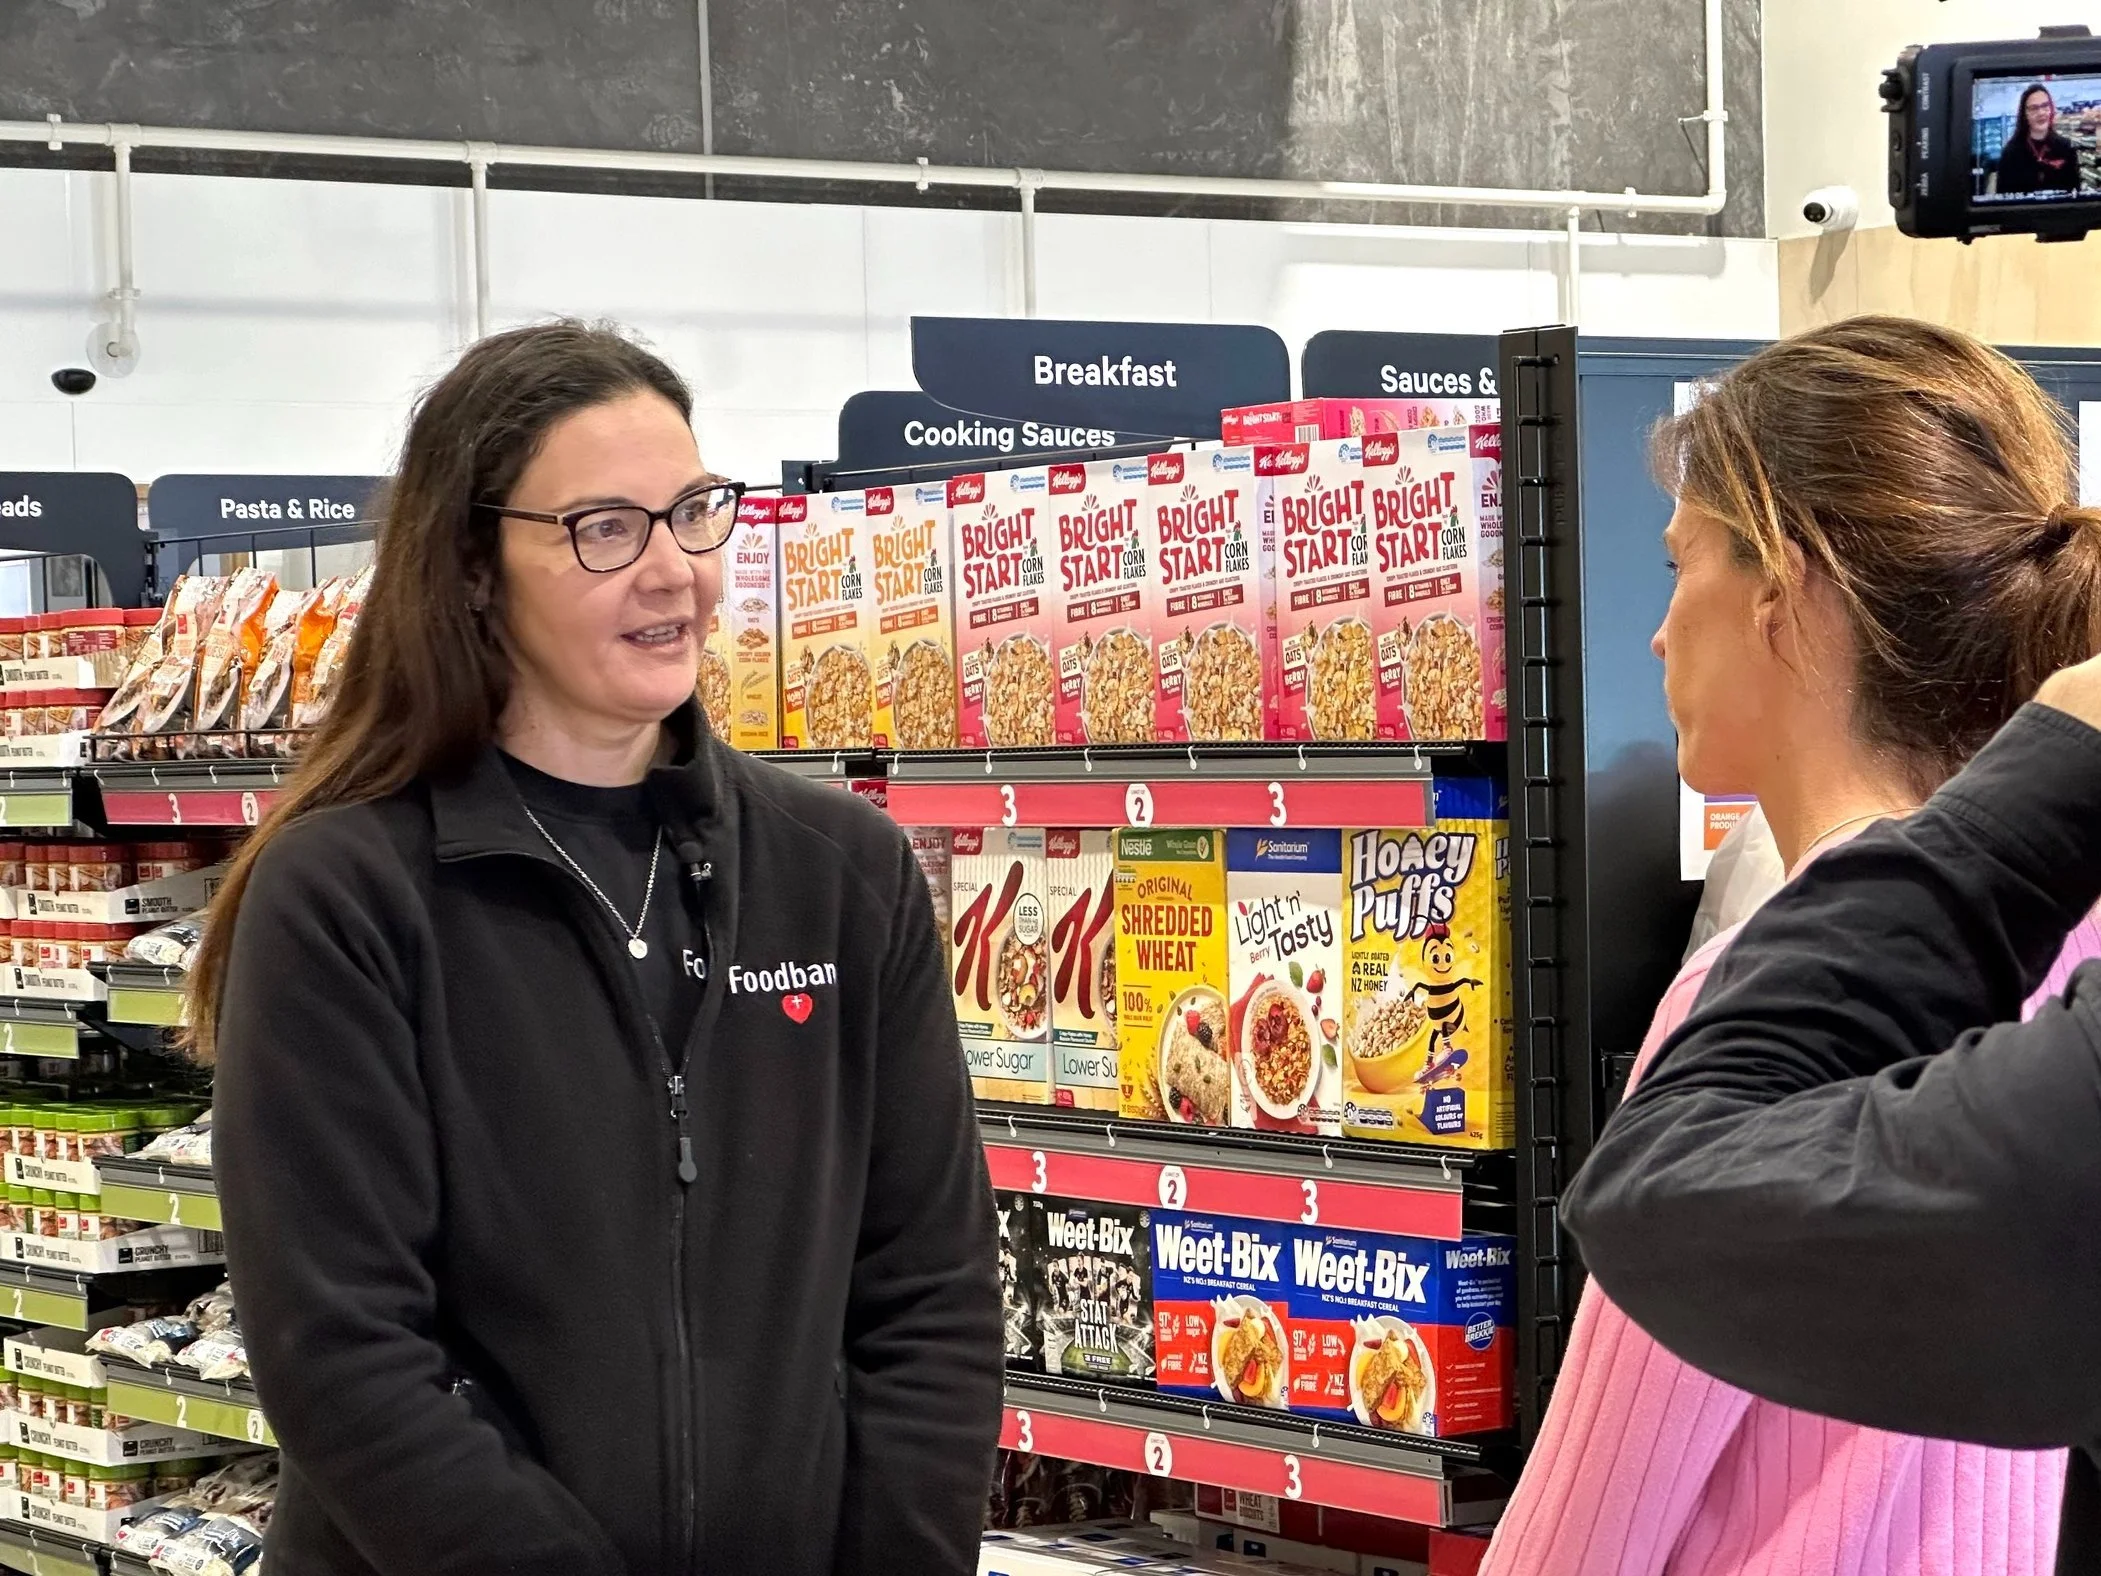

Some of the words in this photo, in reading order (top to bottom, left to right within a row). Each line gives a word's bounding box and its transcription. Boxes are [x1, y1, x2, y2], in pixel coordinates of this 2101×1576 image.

[1033, 355, 1177, 387] Breakfast
[1381, 364, 1473, 395] Sauces
[1478, 366, 1498, 395] &
[905, 421, 1018, 453] Cooking
[1023, 422, 1116, 448] Sauces
[1275, 450, 1305, 470] Kellogg's
[1365, 441, 1396, 461] Kellogg's
[1052, 469, 1083, 489] Kellogg's
[1150, 461, 1180, 480] Kellogg's
[955, 482, 982, 499] Kellogg's
[0, 494, 42, 517] ads
[220, 498, 281, 520] Pasta
[288, 498, 304, 520] &
[309, 498, 355, 520] Rice
[779, 501, 804, 519] Kellogg's
[867, 496, 891, 513] Kellogg's
[1282, 480, 1364, 537] BRIGHT
[1372, 471, 1455, 531] BRIGHT
[1059, 499, 1137, 553] BRIGHT
[1157, 489, 1239, 545] BRIGHT
[962, 507, 1035, 561] BRIGHT
[1441, 527, 1465, 546] CORN
[784, 527, 854, 575] BRIGHT
[872, 520, 936, 570] BRIGHT
[1225, 541, 1248, 559] CORN
[1284, 529, 1352, 579] START
[1375, 521, 1442, 574] START
[1442, 544, 1467, 561] FLAKES
[737, 552, 770, 564] ENJOY
[1022, 556, 1043, 574] CORN
[1123, 549, 1145, 566] CORN
[1159, 536, 1225, 585] START
[1225, 557, 1249, 573] FLAKES
[924, 566, 942, 582] CORN
[963, 552, 1023, 599] START
[1060, 544, 1123, 592] START
[1123, 565, 1146, 579] FLAKES
[841, 573, 862, 589] CORN
[875, 562, 925, 606] START
[924, 581, 943, 595] FLAKES
[1023, 572, 1045, 587] FLAKES
[785, 569, 842, 612] START
[842, 587, 862, 601] FLAKES
[1316, 589, 1322, 602] 8
[1409, 584, 1415, 599] 8
[1091, 602, 1096, 616] 8
[1192, 595, 1197, 609] 8
[992, 608, 997, 621] 8
[1162, 653, 1178, 668] OATS
[1285, 648, 1302, 663] OATS
[1381, 646, 1396, 662] OATS
[965, 663, 979, 678] OATS
[1062, 659, 1077, 673] OATS
[1381, 667, 1401, 683] BERRY
[1062, 678, 1081, 694] BERRY
[1161, 675, 1181, 691] BERRY
[1284, 670, 1305, 686] BERRY
[964, 682, 983, 698] BERRY
[168, 793, 182, 824] 3
[1001, 784, 1017, 827] 3
[1134, 796, 1145, 821] 2
[1269, 782, 1287, 827] 3
[1710, 812, 1740, 821] ORANGE
[912, 837, 946, 849] ENJOY
[953, 833, 979, 850] Kellogg's
[1049, 837, 1077, 855] Kellogg's
[1268, 840, 1308, 853] Sanitarium
[953, 882, 977, 892] SPECIAL
[1050, 886, 1077, 897] SPECIAL
[1137, 876, 1193, 901] ORIGINAL
[142, 897, 172, 907] SMOOTH
[1019, 906, 1038, 916] LESS
[1350, 873, 1456, 943] Puffs
[1019, 925, 1038, 933] SUGAR
[1122, 904, 1213, 937] SHREDDED
[1235, 895, 1285, 946] Light
[954, 860, 1024, 1011] K
[1268, 909, 1333, 961] Tasty
[1136, 939, 1197, 972] WHEAT
[1250, 946, 1270, 964] Berry
[1363, 963, 1388, 977] REAL
[1351, 977, 1363, 992] NZ
[1364, 979, 1388, 992] HONEY
[1122, 991, 1153, 1013] 100%
[966, 1049, 994, 1066] ower
[996, 1046, 1034, 1074] Sugar
[1063, 1053, 1099, 1077] Lower
[1443, 1095, 1451, 1103] NO
[1435, 1113, 1456, 1121] COLOURS
[1437, 1120, 1461, 1130] FLAVOURS
[1470, 1130, 1483, 1140] 425g
[1031, 1151, 1048, 1195] 3
[1167, 1180, 1177, 1204] 2
[169, 1193, 181, 1226] 2
[1300, 1179, 1319, 1226] 3
[1047, 1211, 1134, 1256] Weet-Bix
[135, 1245, 168, 1255] CRUNCHY
[1156, 1223, 1281, 1283] Weet-Bix
[1445, 1247, 1511, 1269] Weet-Bix
[1293, 1238, 1430, 1303] Weet-Bix
[1207, 1279, 1236, 1289] BREAKFAST
[1236, 1282, 1255, 1292] CEREAL
[13, 1289, 23, 1320] 2
[1080, 1298, 1108, 1325] STAT
[1347, 1297, 1377, 1309] BREAKFAST
[1378, 1302, 1399, 1312] CEREAL
[1185, 1315, 1199, 1327] LOW
[1468, 1319, 1492, 1334] BETTER
[1074, 1318, 1119, 1353] ATTACK
[1322, 1334, 1337, 1347] LOW
[1465, 1326, 1494, 1343] BREKKIE
[1092, 1355, 1111, 1365] FREE
[1167, 1360, 1182, 1371] FIBRE
[1198, 1353, 1207, 1364] NZ
[1300, 1380, 1317, 1392] FIBRE
[1334, 1374, 1344, 1387] NZ
[176, 1395, 187, 1427] 2
[253, 1420, 258, 1439] 2
[1016, 1411, 1034, 1453] 3
[140, 1437, 173, 1448] CRUNCHY
[1154, 1446, 1163, 1470] 2
[1284, 1455, 1302, 1499] 3
[1240, 1491, 1261, 1509] WHEAT
